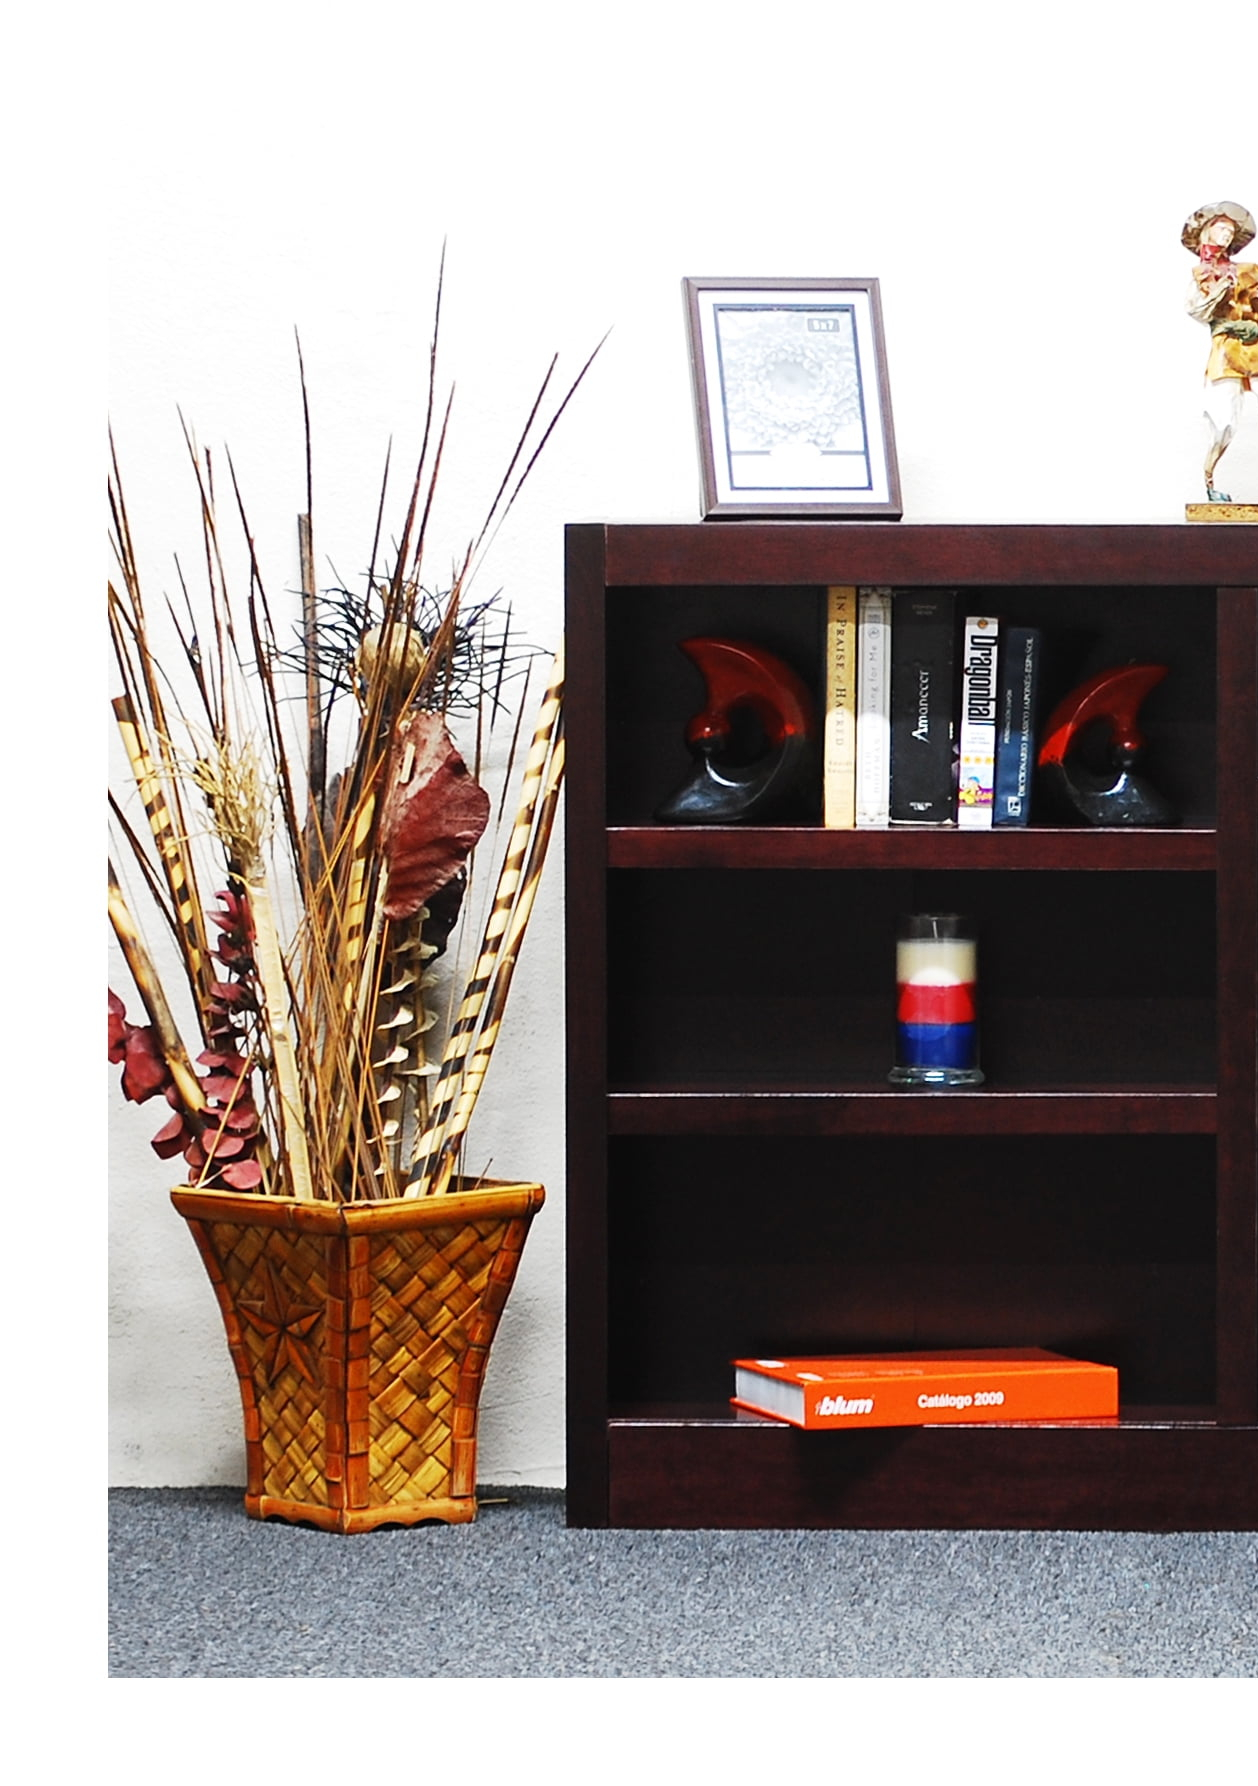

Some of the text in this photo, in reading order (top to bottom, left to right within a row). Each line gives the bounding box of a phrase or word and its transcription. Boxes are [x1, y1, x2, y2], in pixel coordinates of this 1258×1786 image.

[837, 595, 846, 611] IN
[835, 619, 846, 669] PRAISE
[835, 688, 845, 747] HATRED
[912, 670, 930, 743] Amanecer
[819, 1397, 874, 1415] blum
[918, 1392, 1004, 1410] Catálogo 2009
